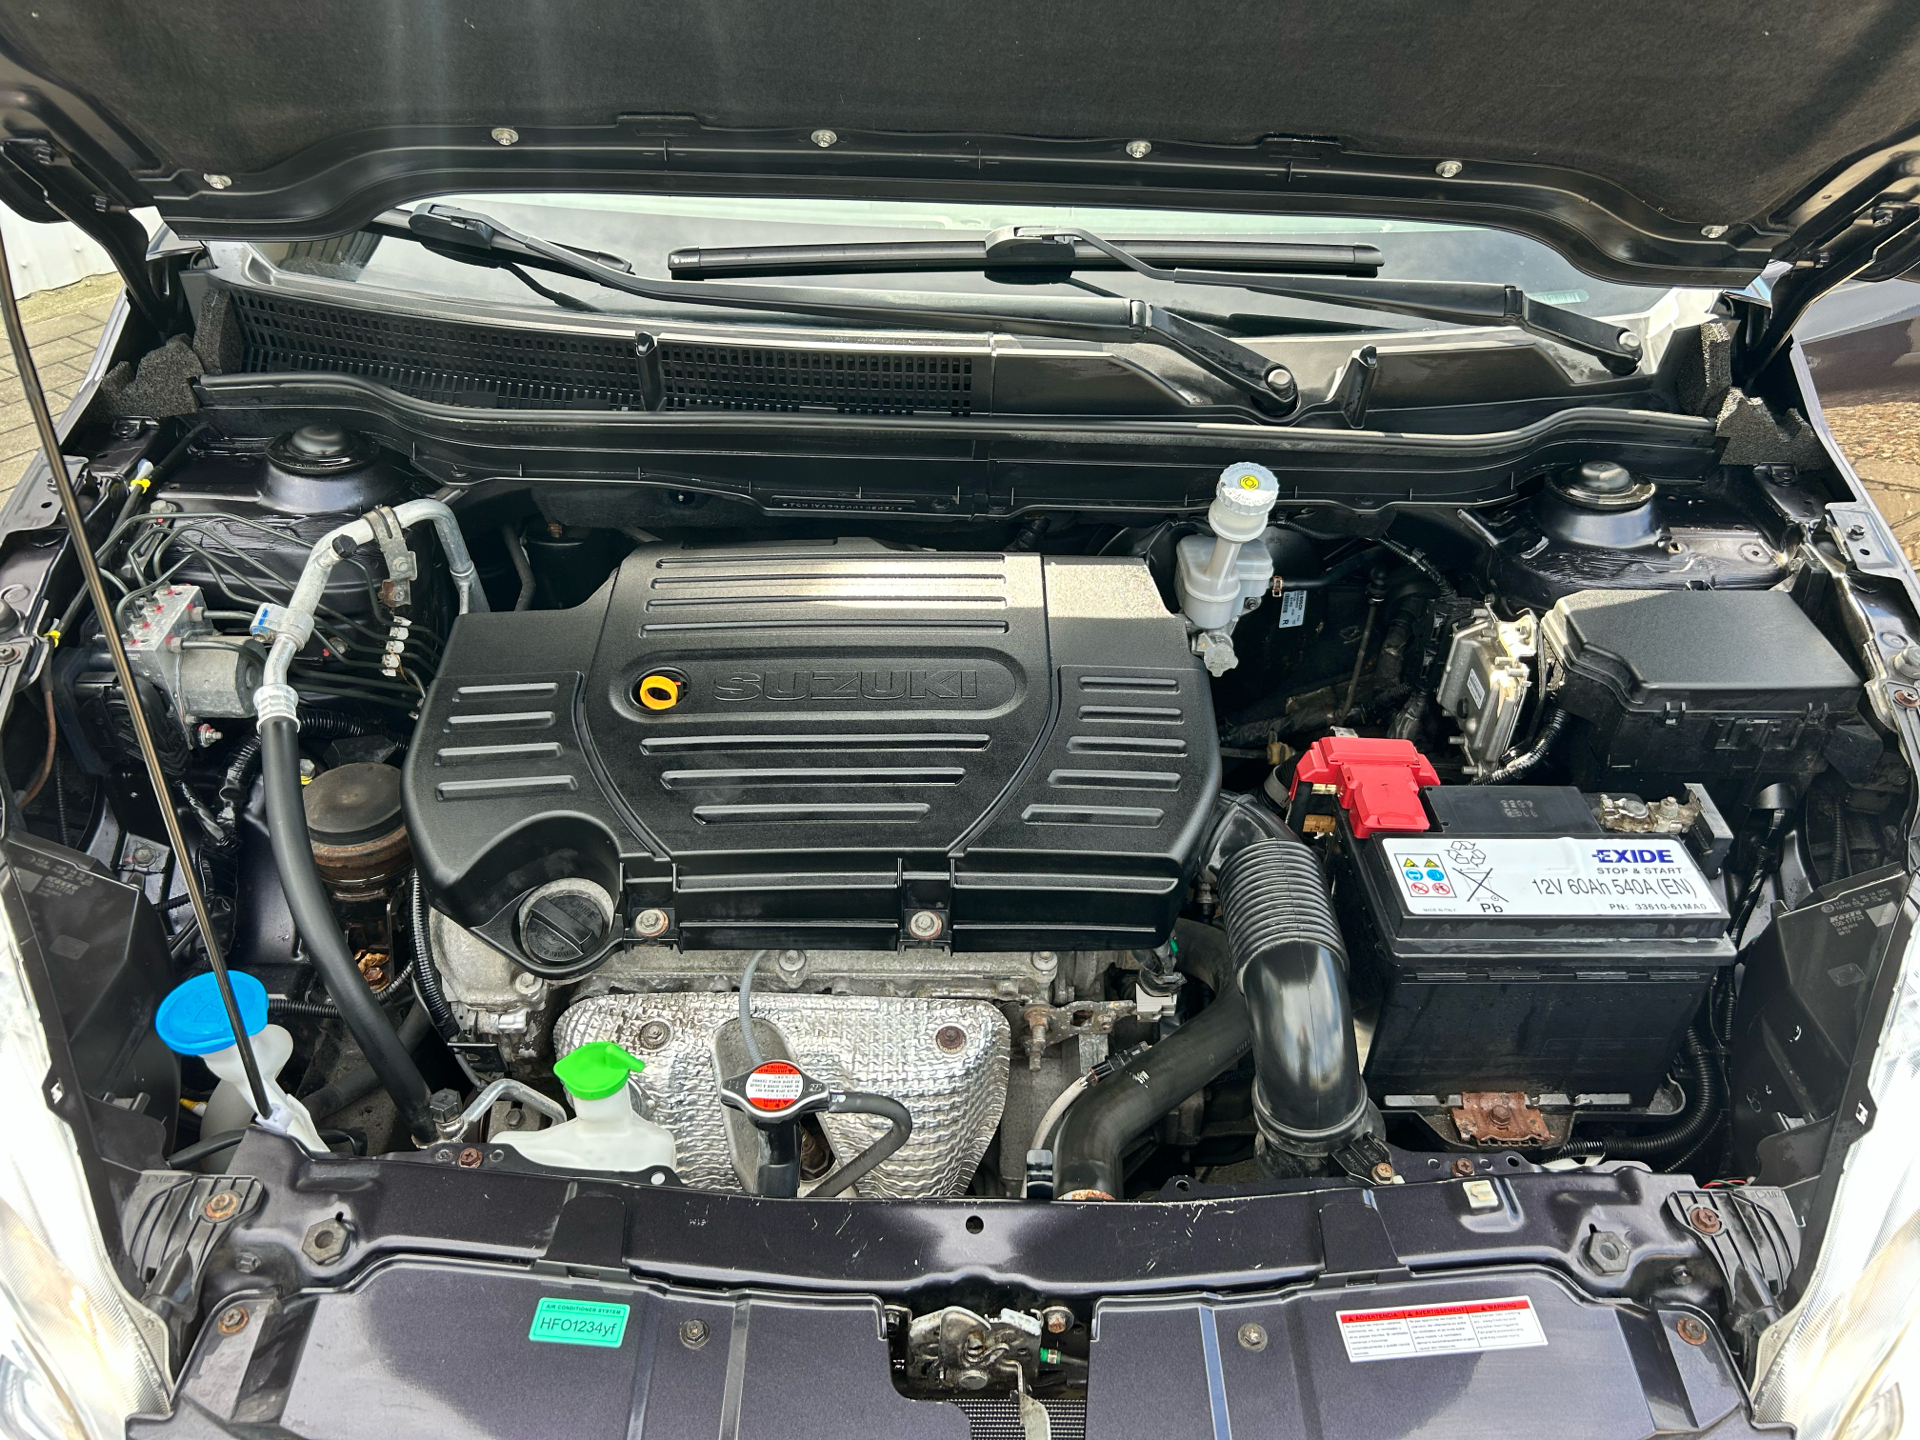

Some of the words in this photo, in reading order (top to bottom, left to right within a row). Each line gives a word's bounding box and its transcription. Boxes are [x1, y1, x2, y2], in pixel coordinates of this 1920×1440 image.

[713, 671, 977, 700] SUZUKI
[1592, 849, 1674, 863] EXIDE
[1532, 878, 1562, 894] 12V
[1567, 878, 1611, 894] 60Ah
[1612, 878, 1658, 895] 540A
[1657, 878, 1697, 899] (EN)
[1480, 902, 1503, 913] Pb
[558, 1304, 596, 1312] CONDITIONER
[1415, 1306, 1464, 1315] AVERTISSEMENT
[1355, 1312, 1398, 1321] ADVERTENCIA
[540, 1317, 617, 1337] HFO1234yf
